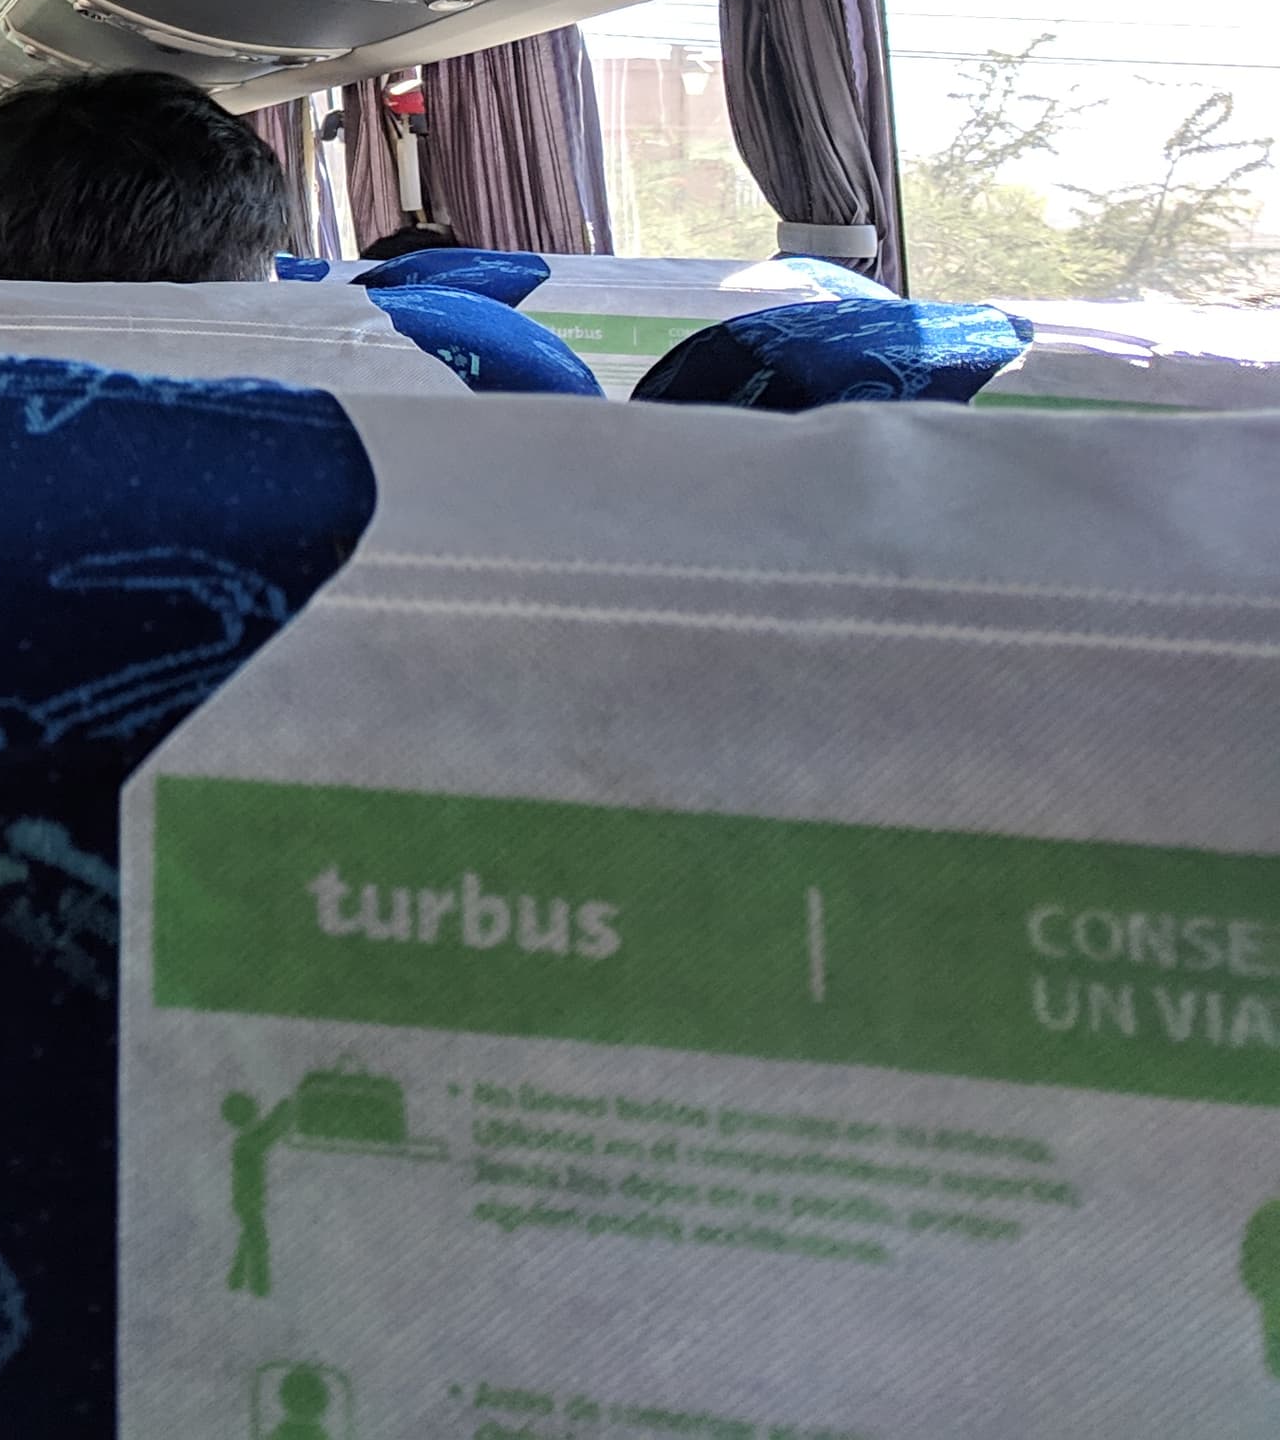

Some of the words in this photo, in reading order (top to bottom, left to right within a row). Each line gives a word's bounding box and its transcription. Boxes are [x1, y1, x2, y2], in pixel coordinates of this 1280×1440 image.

[309, 866, 622, 960] turbus
[1025, 905, 1280, 976] CONSE
[1033, 972, 1136, 1037] UN
[1153, 984, 1280, 1048] VIA
